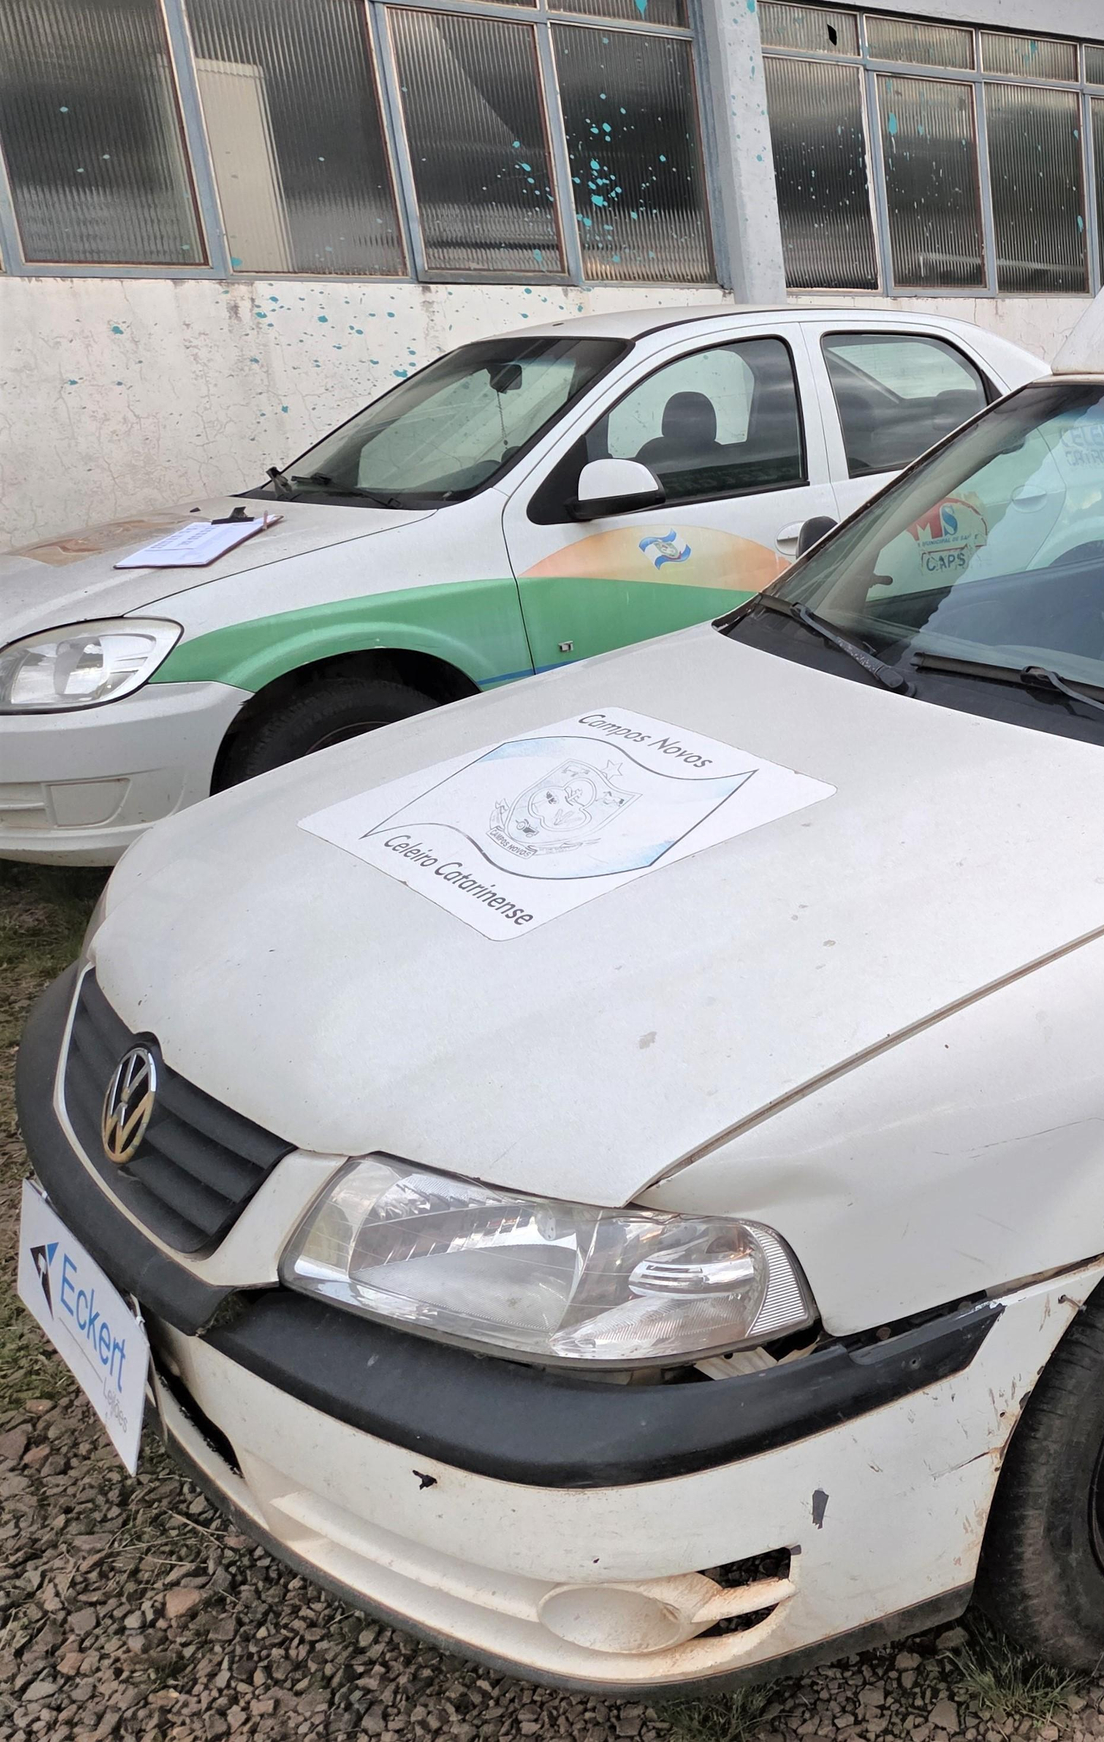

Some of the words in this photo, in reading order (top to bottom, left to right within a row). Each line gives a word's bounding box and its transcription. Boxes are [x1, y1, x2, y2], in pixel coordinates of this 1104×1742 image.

[926, 552, 966, 572] CAPS
[578, 713, 651, 743] Campos
[650, 737, 713, 769] Novos
[490, 829, 510, 847] CAMPOS
[508, 844, 531, 857] NOVOS
[383, 834, 438, 868] Celeiro
[434, 861, 534, 926] Catarinense
[60, 1253, 126, 1393] Eckert
